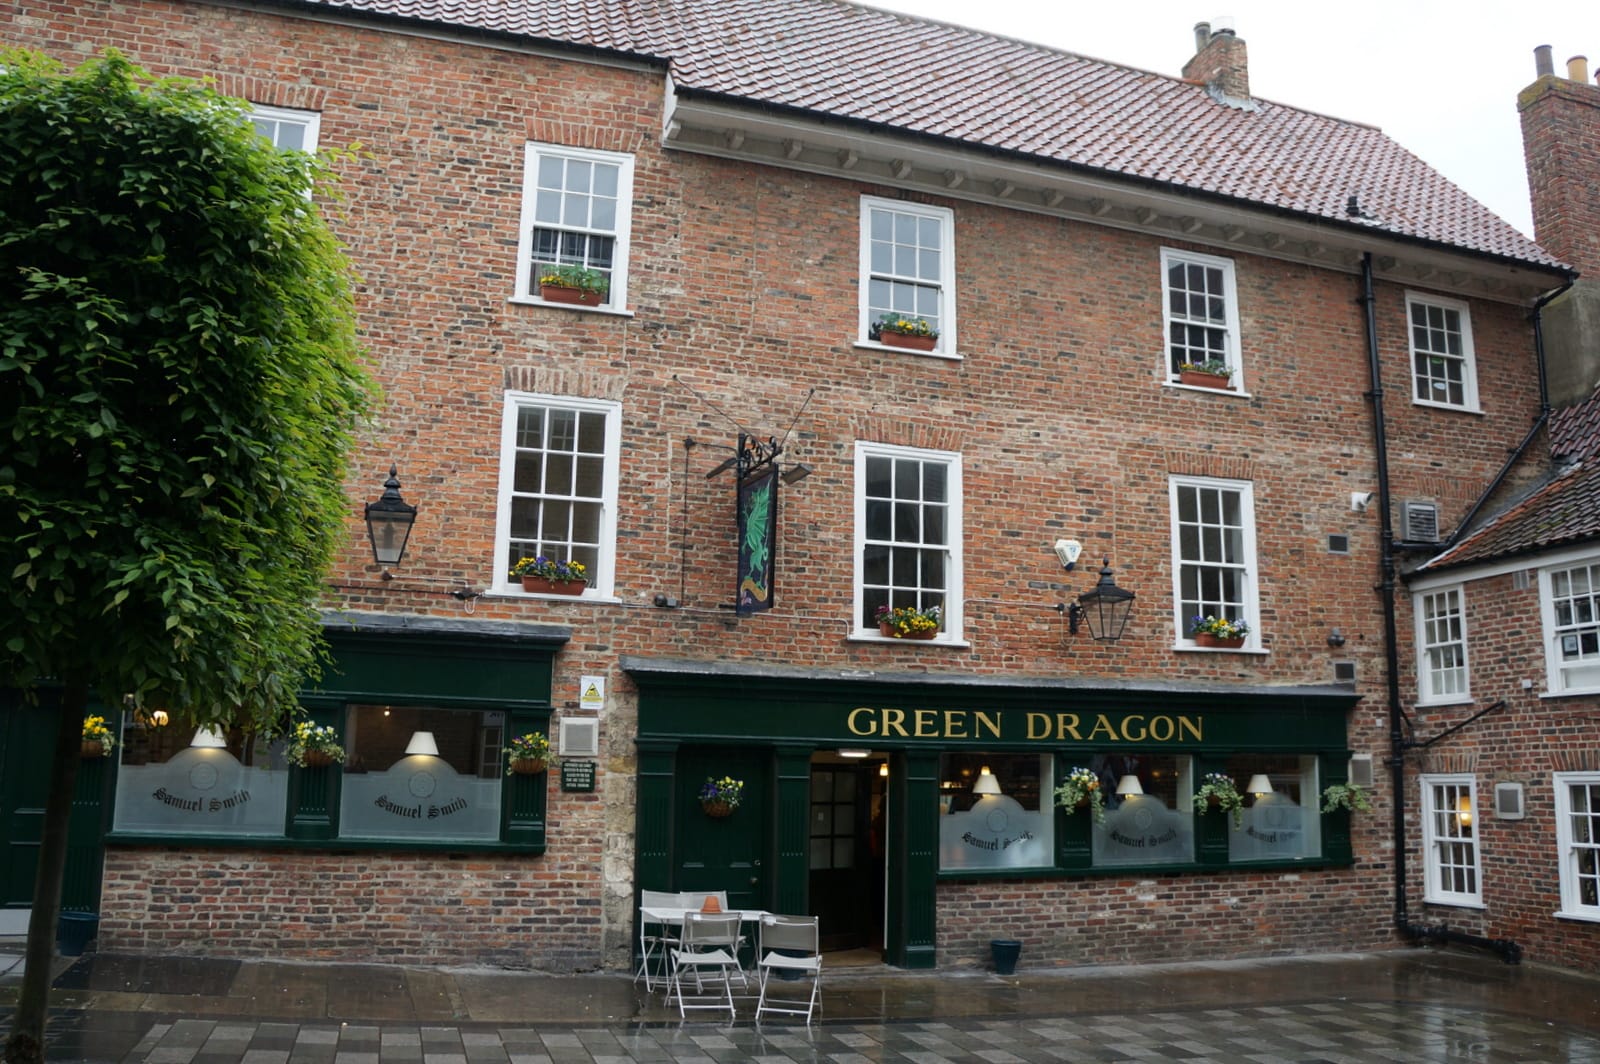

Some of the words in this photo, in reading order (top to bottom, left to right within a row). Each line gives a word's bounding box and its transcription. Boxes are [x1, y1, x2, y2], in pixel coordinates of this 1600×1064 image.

[846, 707, 1002, 740] GREEN
[1025, 712, 1204, 742] DRAGON
[151, 786, 203, 811] Samuel
[208, 788, 252, 812] Smith
[374, 794, 422, 818] Samuel
[427, 796, 468, 819] Smith
[961, 831, 998, 850] Samuel
